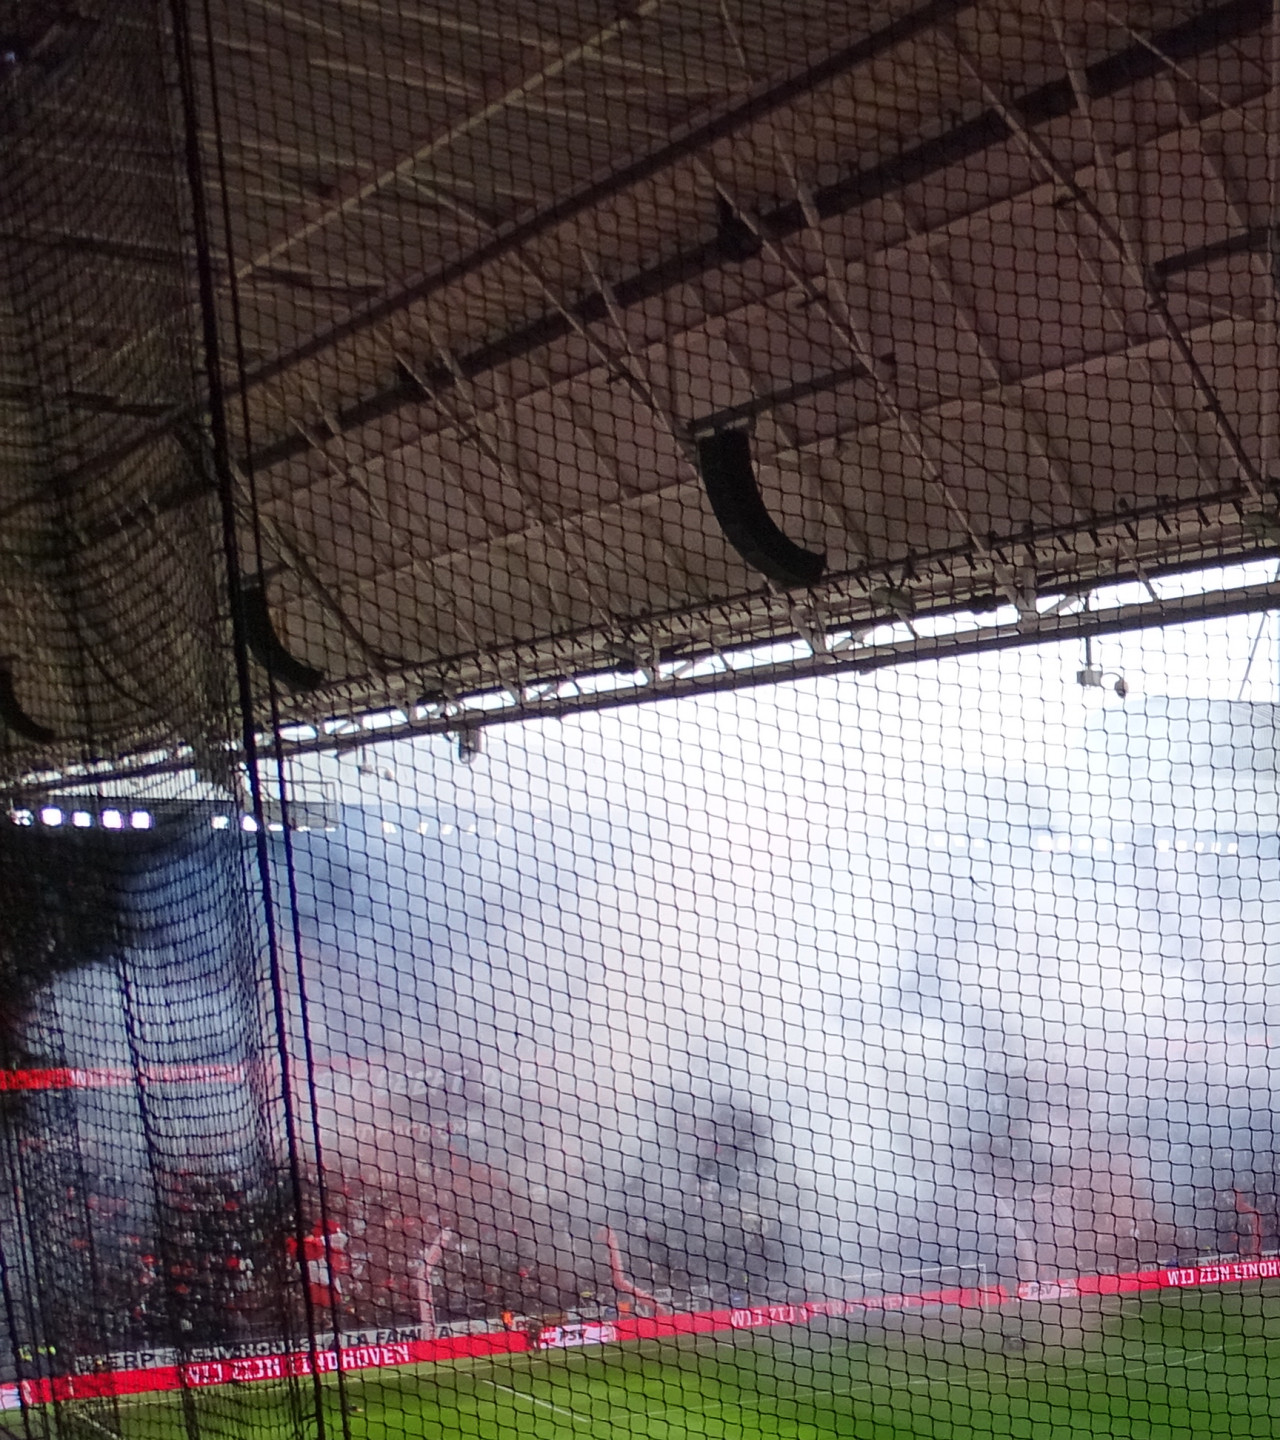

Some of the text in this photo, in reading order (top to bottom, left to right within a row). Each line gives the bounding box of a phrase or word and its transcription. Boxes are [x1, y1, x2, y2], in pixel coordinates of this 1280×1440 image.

[1167, 1269, 1194, 1286] WIJ
[1199, 1265, 1230, 1283] ZIJN
[1030, 1284, 1053, 1297] PSV
[731, 1308, 762, 1327] WIJ
[186, 1360, 223, 1385] WIJ
[232, 1357, 281, 1380] ZIJN
